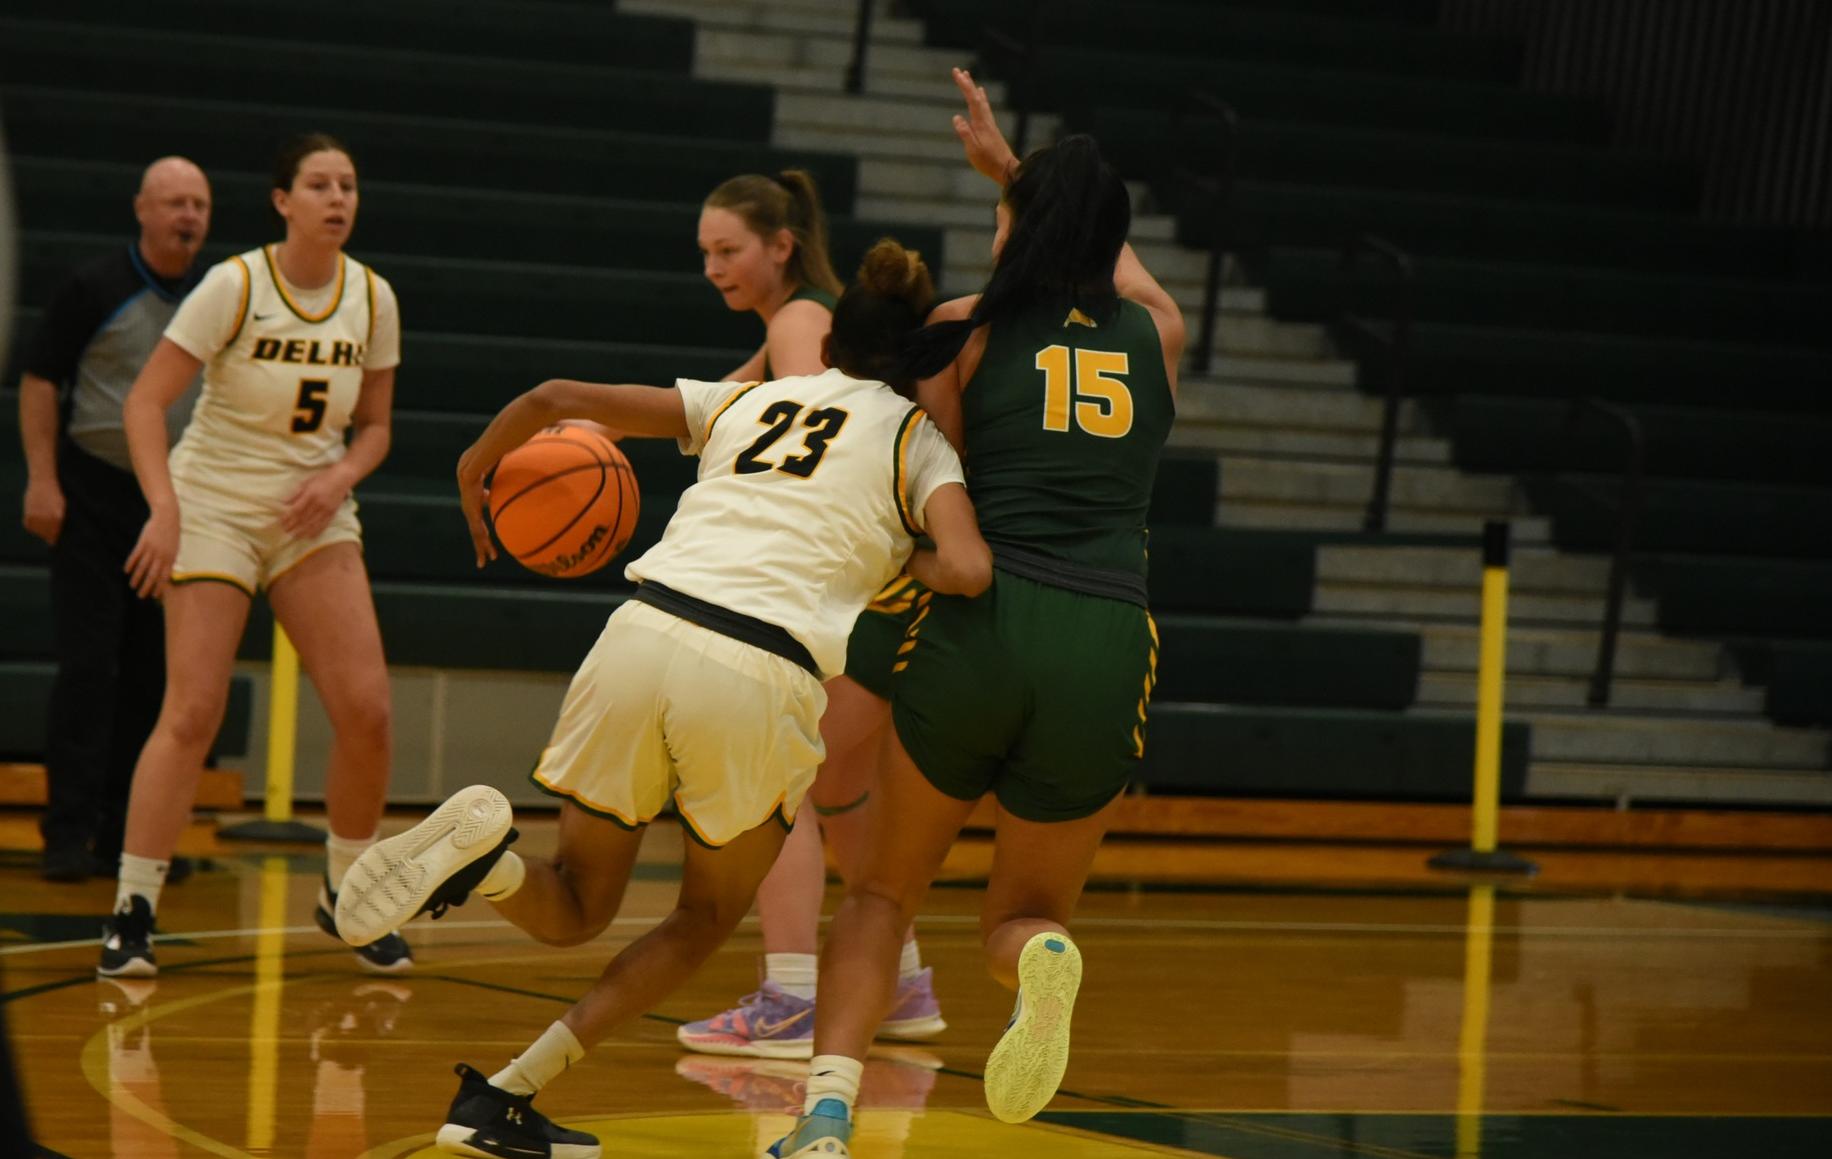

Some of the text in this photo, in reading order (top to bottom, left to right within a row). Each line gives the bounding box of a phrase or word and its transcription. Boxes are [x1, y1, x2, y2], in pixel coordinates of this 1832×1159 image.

[290, 378, 330, 434] 5
[1035, 344, 1134, 438] 15
[733, 399, 849, 480] 23
